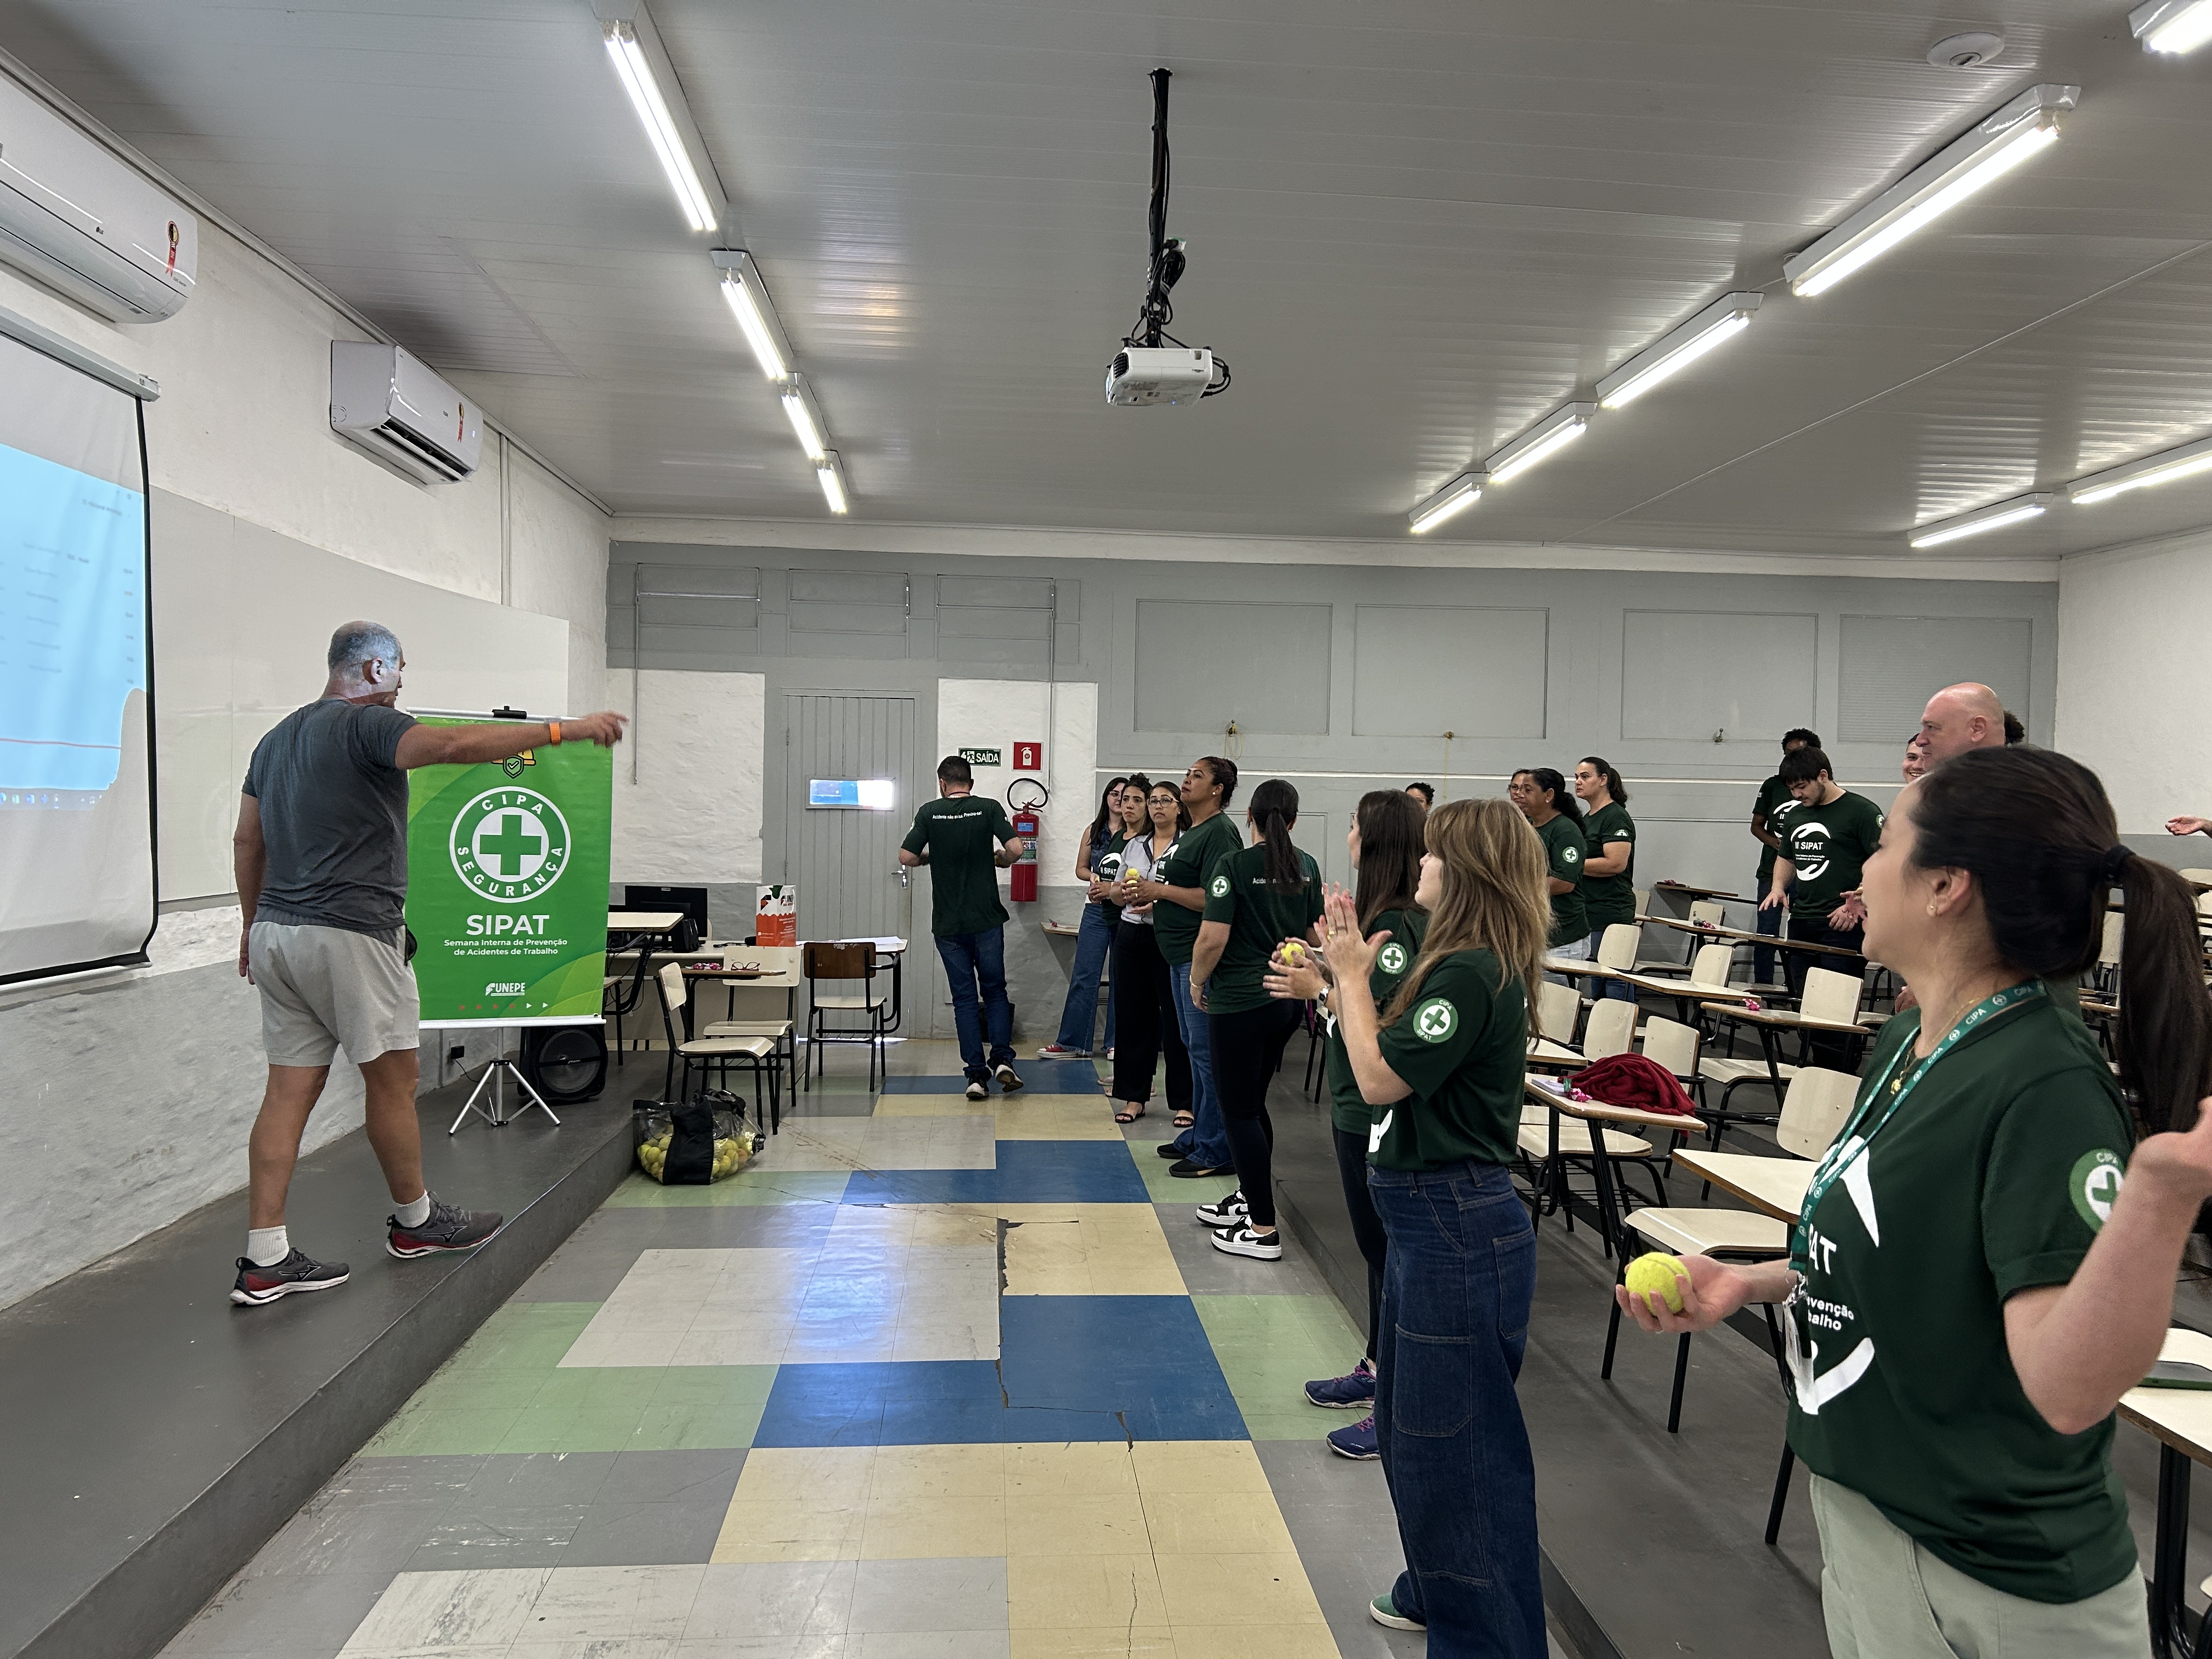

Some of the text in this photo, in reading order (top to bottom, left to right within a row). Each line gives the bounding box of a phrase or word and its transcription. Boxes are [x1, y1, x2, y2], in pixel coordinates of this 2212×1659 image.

[976, 751, 999, 763] SAÍDA
[482, 794, 543, 815] CIPA
[1801, 842, 1824, 850] SIPAT
[458, 847, 563, 896] SEGURANÇA
[466, 915, 550, 935] SIPAT
[1438, 1000, 1452, 1011] CIPA
[1965, 1008, 1987, 1025] CIPA
[1927, 1047, 1943, 1064] CIPA
[1894, 1088, 1908, 1105] CIPA
[1829, 1168, 1843, 1183] CIPA
[1803, 1204, 1813, 1221] CIPA
[1807, 1296, 1854, 1321] venção
